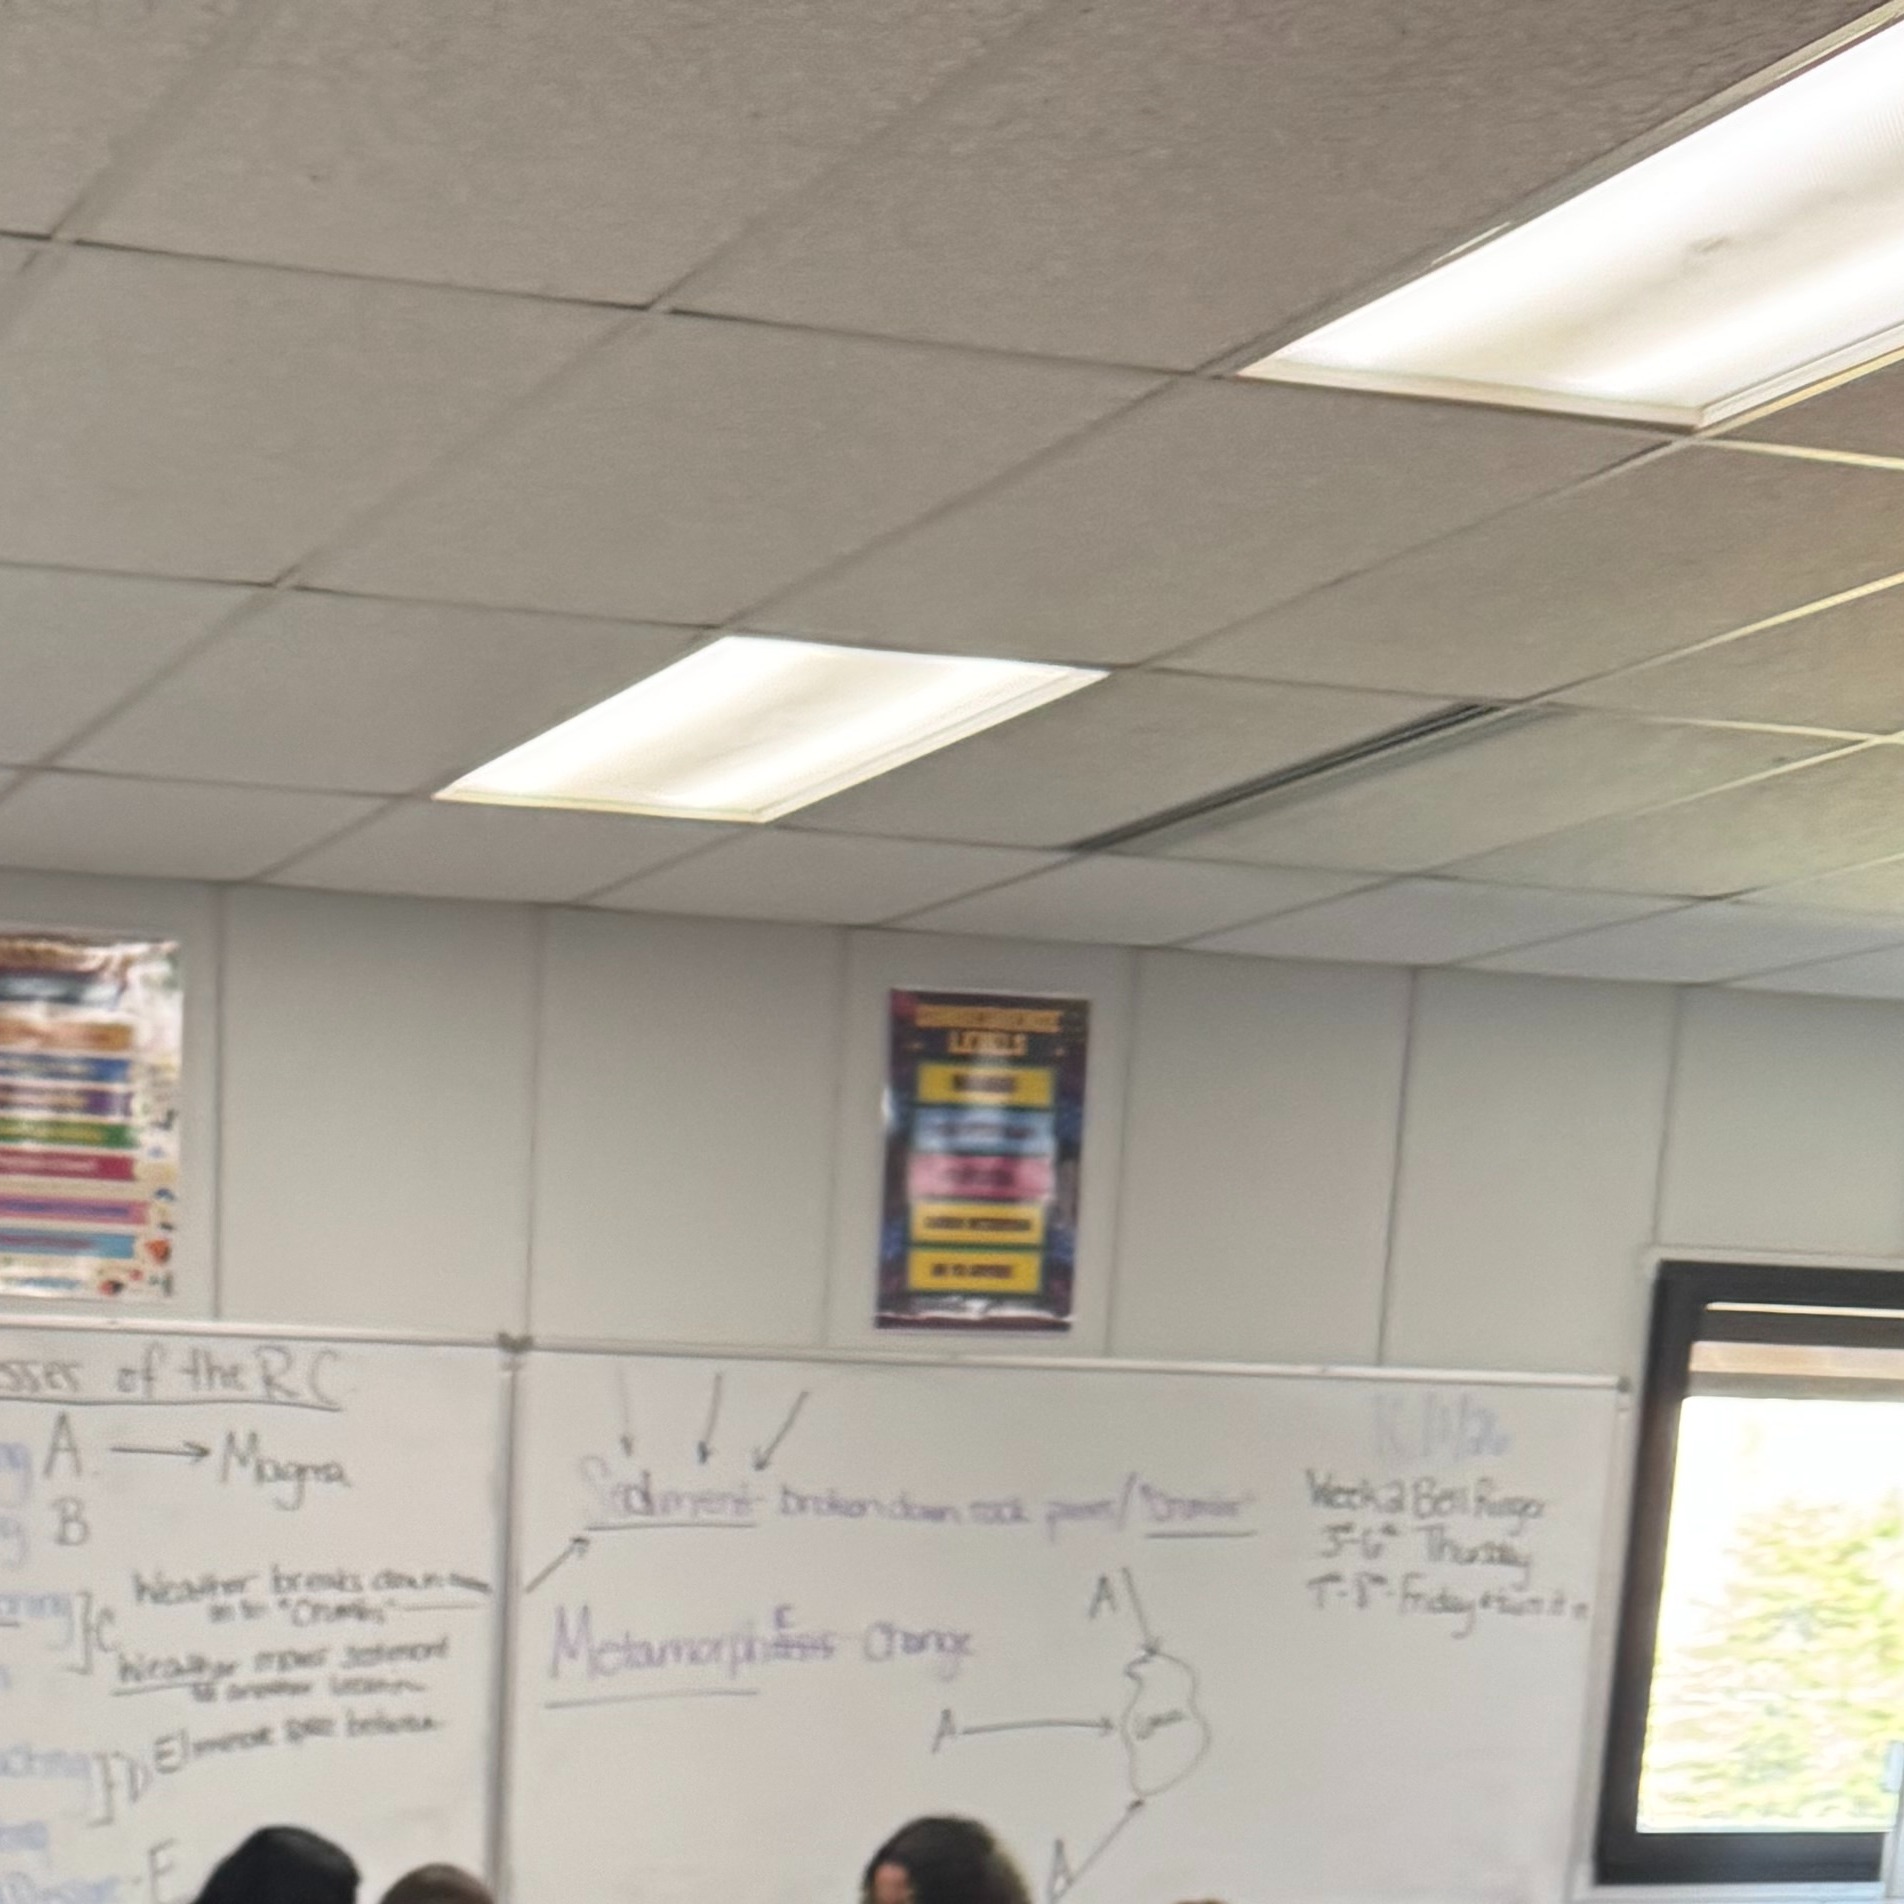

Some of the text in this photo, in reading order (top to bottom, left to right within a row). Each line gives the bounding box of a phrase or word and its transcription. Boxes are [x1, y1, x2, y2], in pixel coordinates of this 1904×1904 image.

[115, 1343, 163, 1394] of
[42, 1412, 82, 1478] A
[53, 1498, 90, 1546] B
